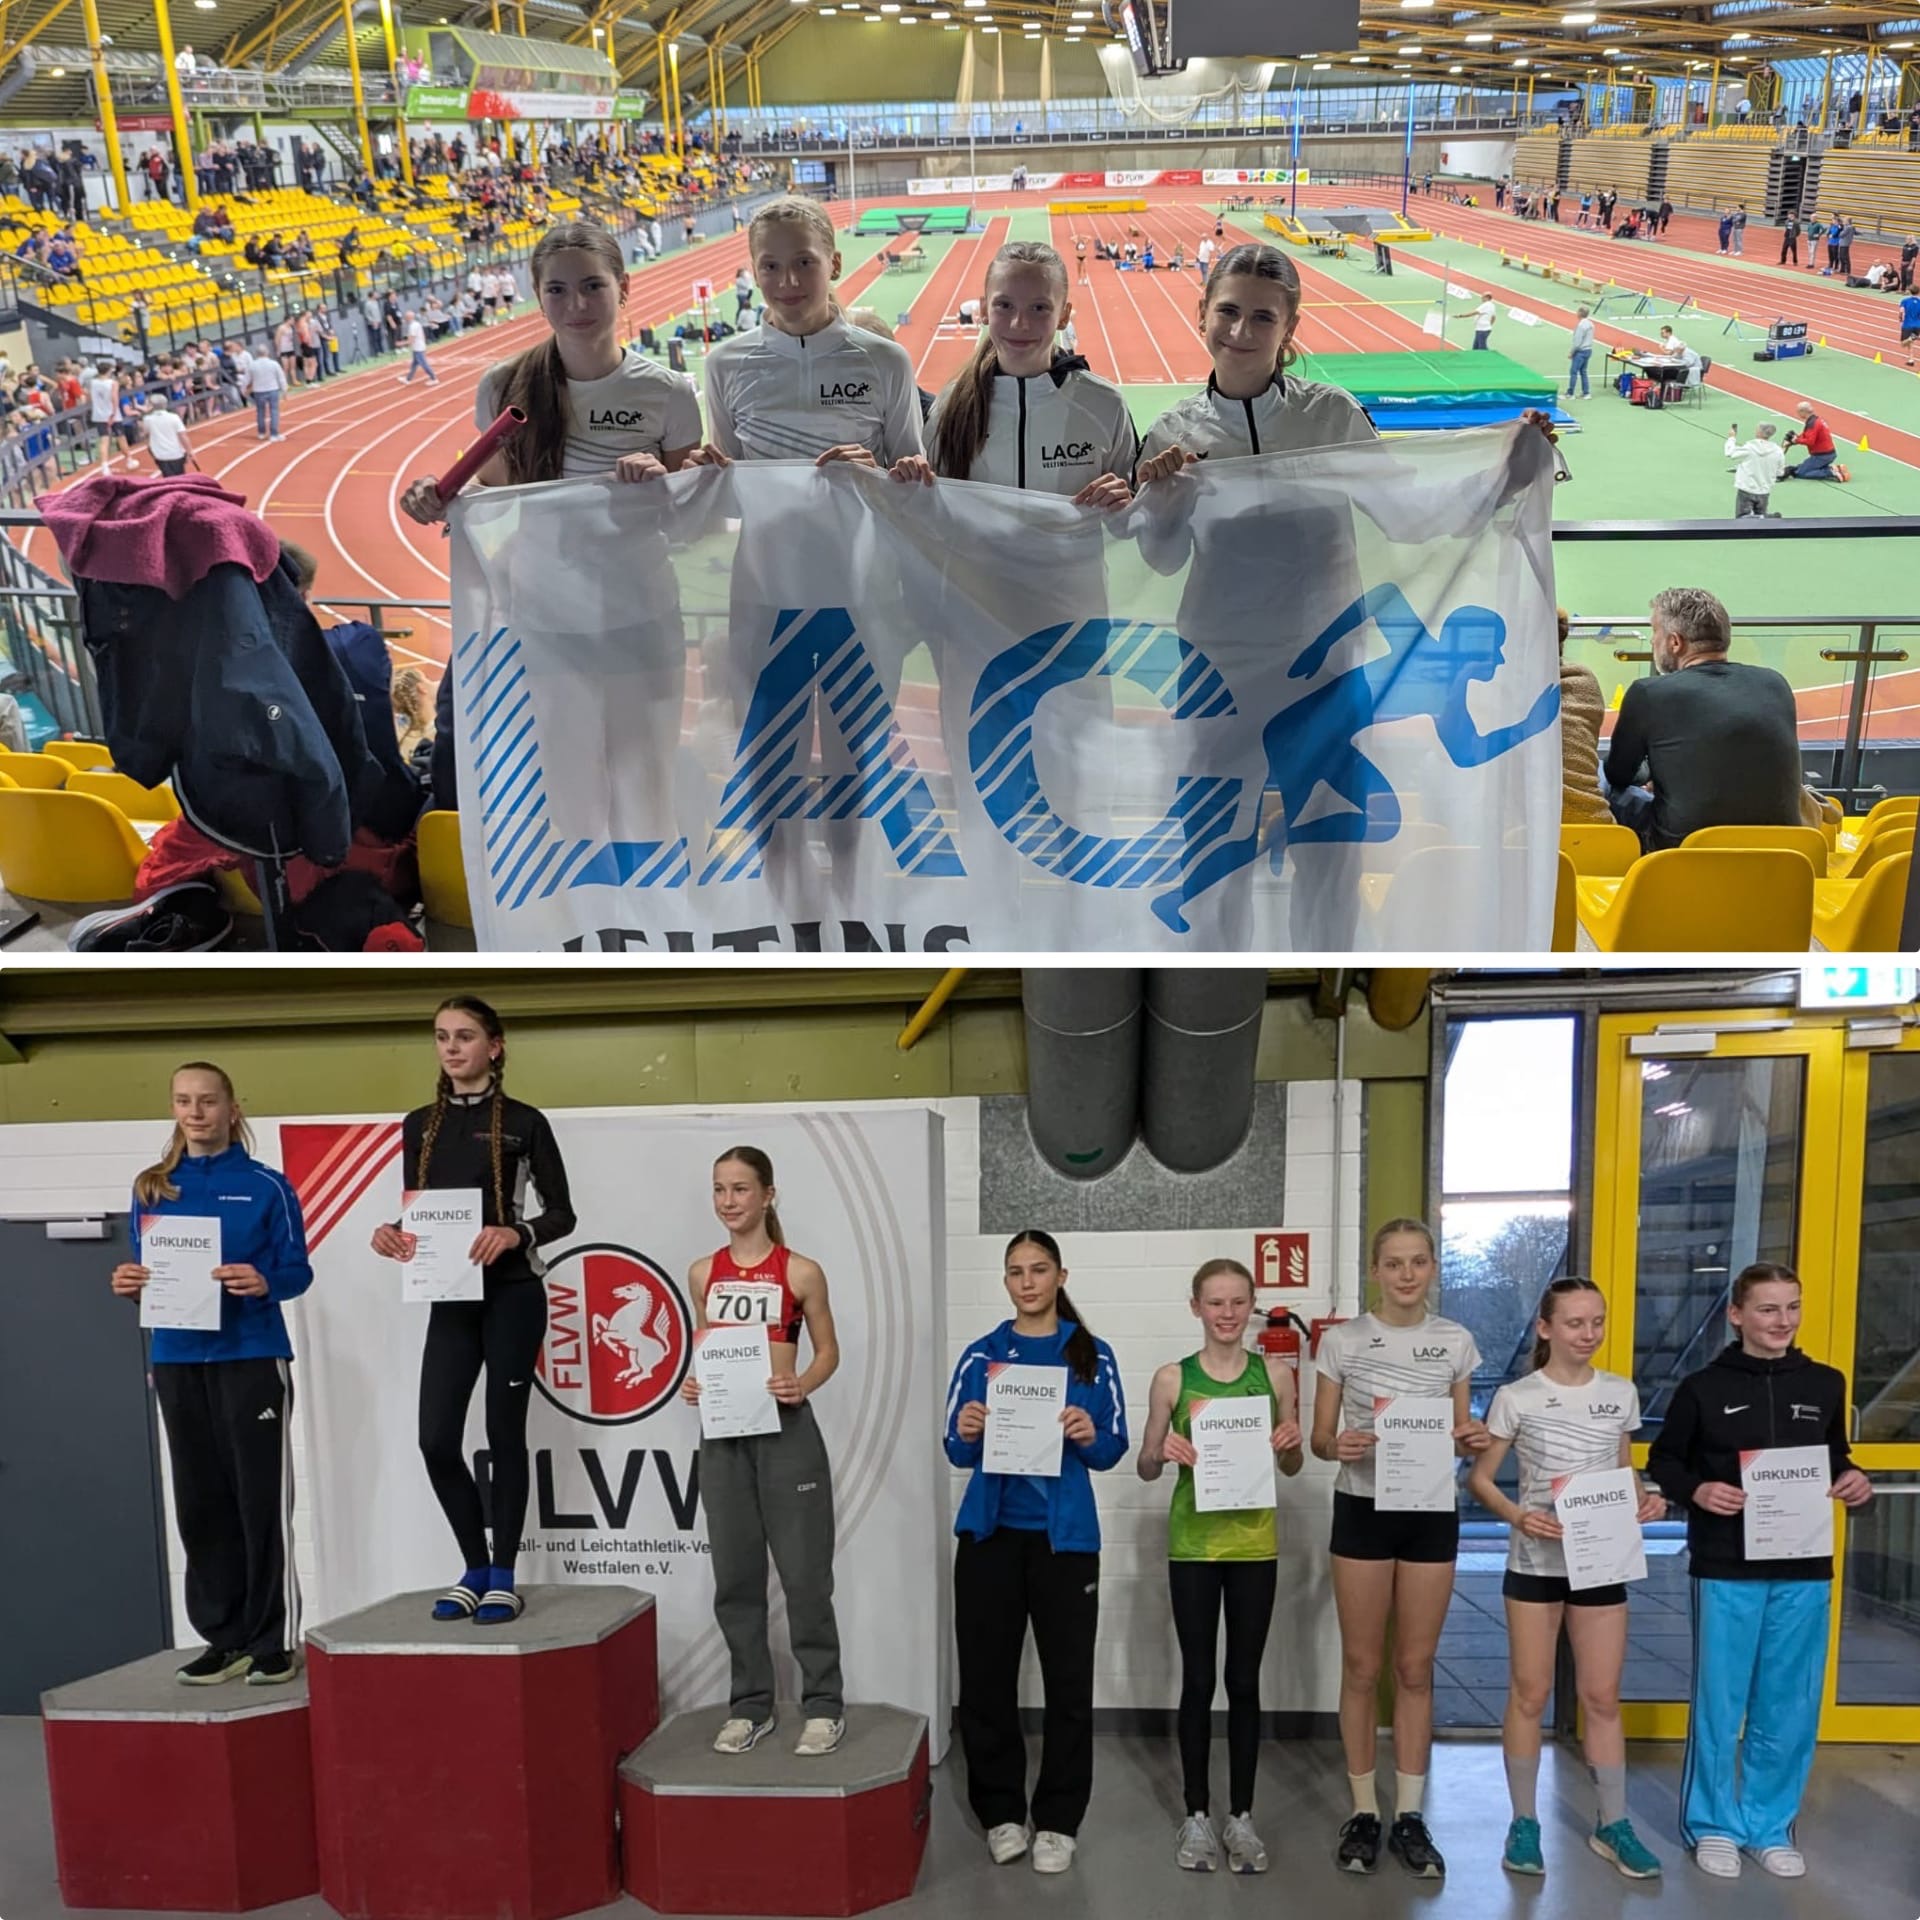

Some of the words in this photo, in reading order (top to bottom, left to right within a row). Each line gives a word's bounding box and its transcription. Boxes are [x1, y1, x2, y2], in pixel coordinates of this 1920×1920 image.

[410, 1209, 473, 1222] URKUNDE
[149, 1235, 213, 1250] URKUNDE
[717, 1295, 768, 1322] 701
[548, 1282, 584, 1390] FLVW
[702, 1345, 762, 1361] URKUNDE
[995, 1383, 1058, 1399] URKUNDE
[1199, 1416, 1263, 1432] URKUNDE
[1383, 1417, 1446, 1431] URKUNDE
[1752, 1467, 1821, 1483] URKUNDE
[1563, 1489, 1629, 1510] URKUNDE
[546, 1539, 576, 1553] und
[580, 1539, 713, 1554] Leichtathletik-Ve
[563, 1560, 641, 1576] Westfalen
[644, 1561, 673, 1576] e.V.
